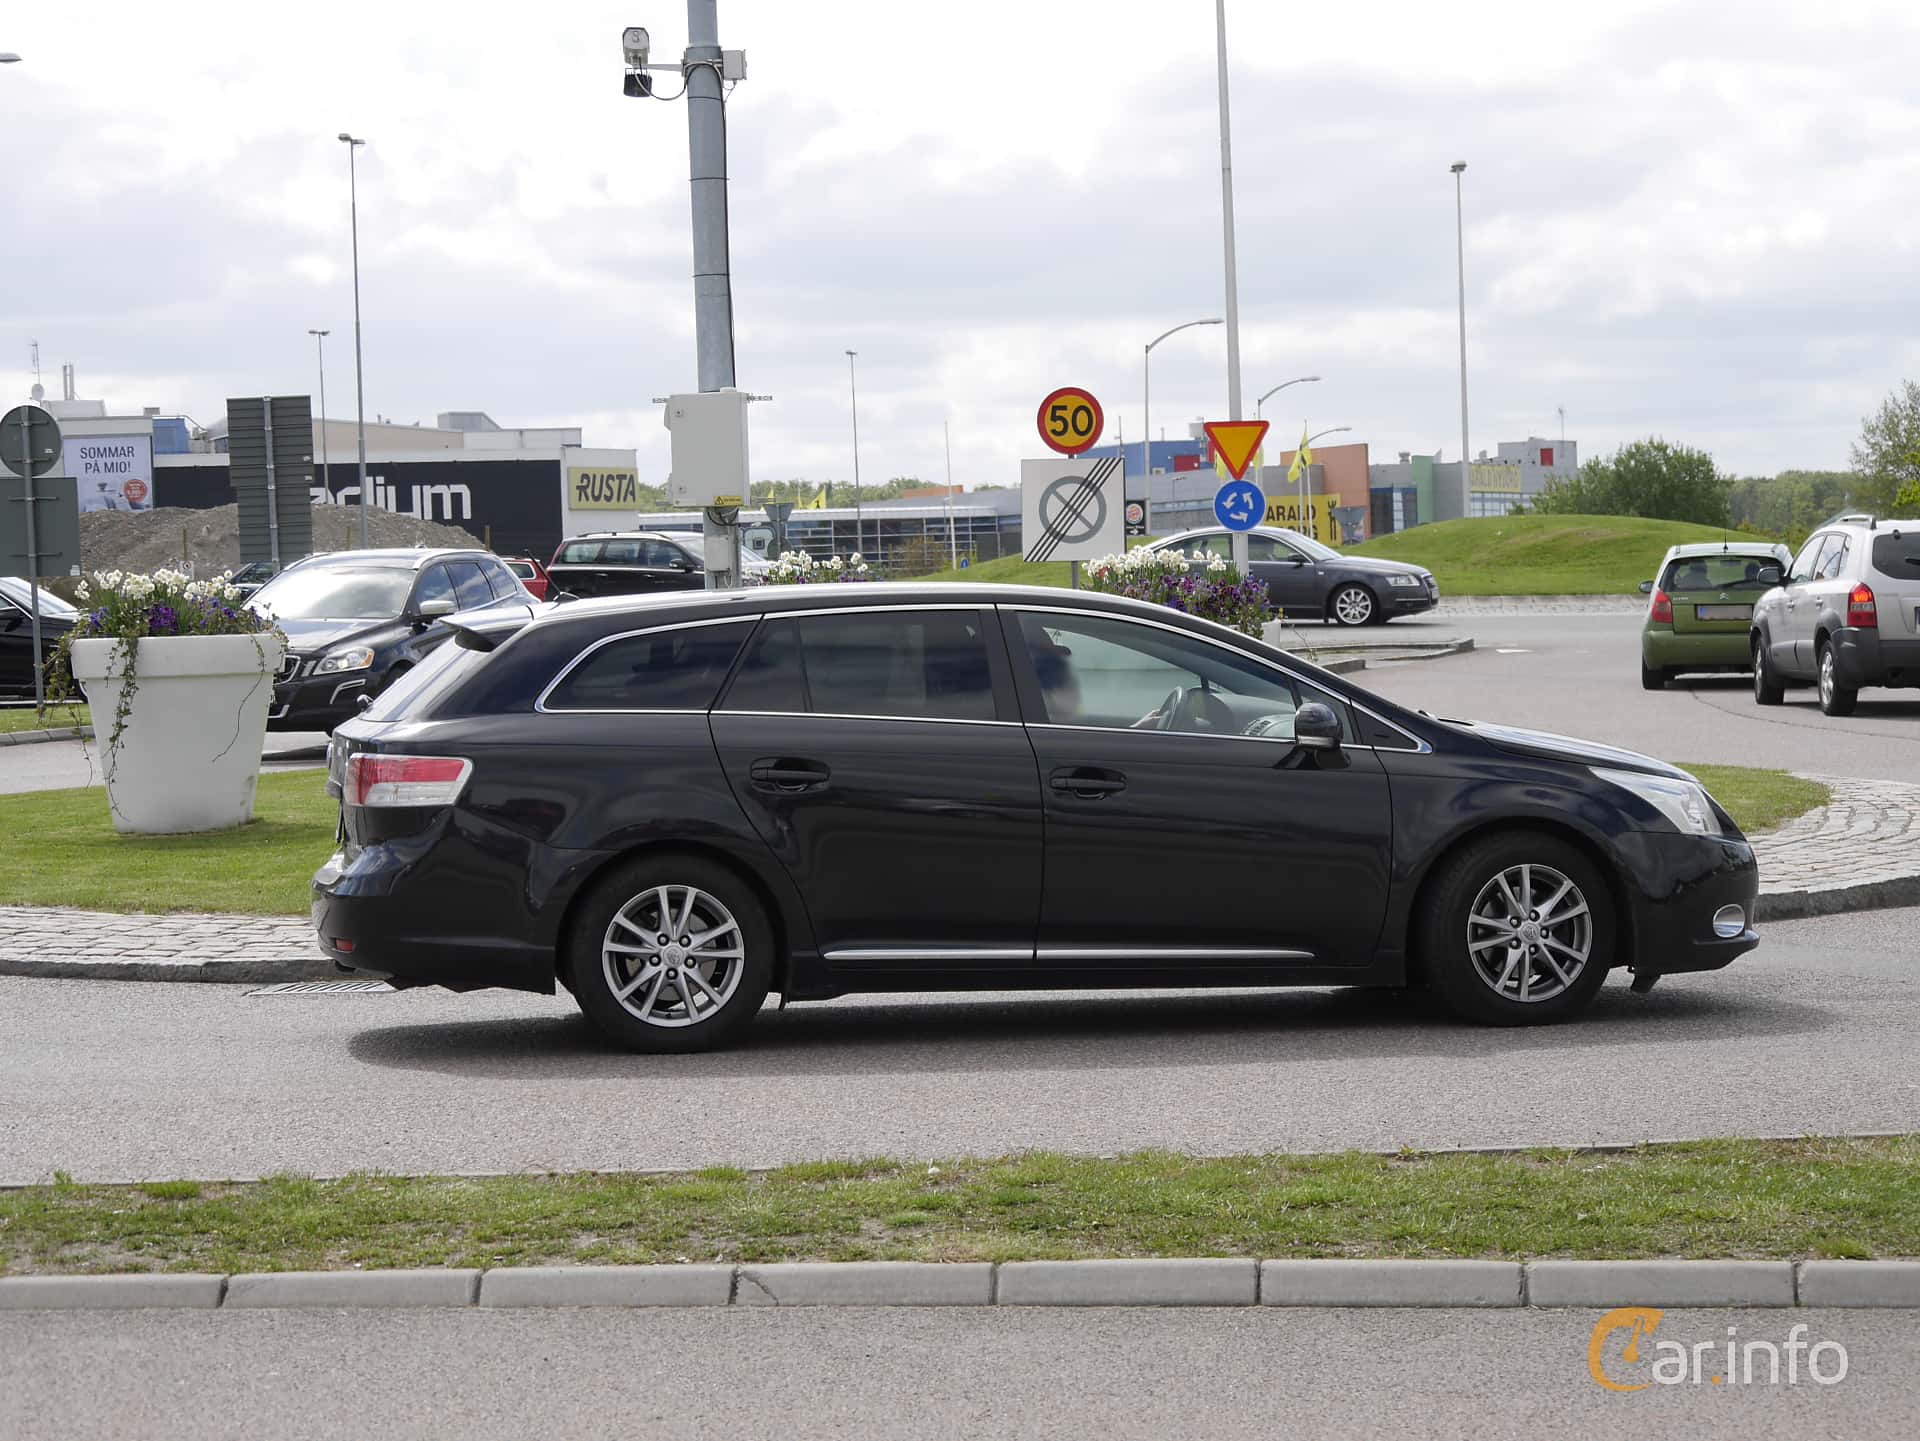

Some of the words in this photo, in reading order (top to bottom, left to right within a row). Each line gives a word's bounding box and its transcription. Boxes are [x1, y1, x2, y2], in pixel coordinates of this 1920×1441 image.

[1050, 405, 1094, 436] 50
[80, 446, 135, 459] SOMMAR
[85, 460, 100, 474] PÅ
[104, 461, 131, 474] MIO!
[576, 473, 636, 503] RUSTA
